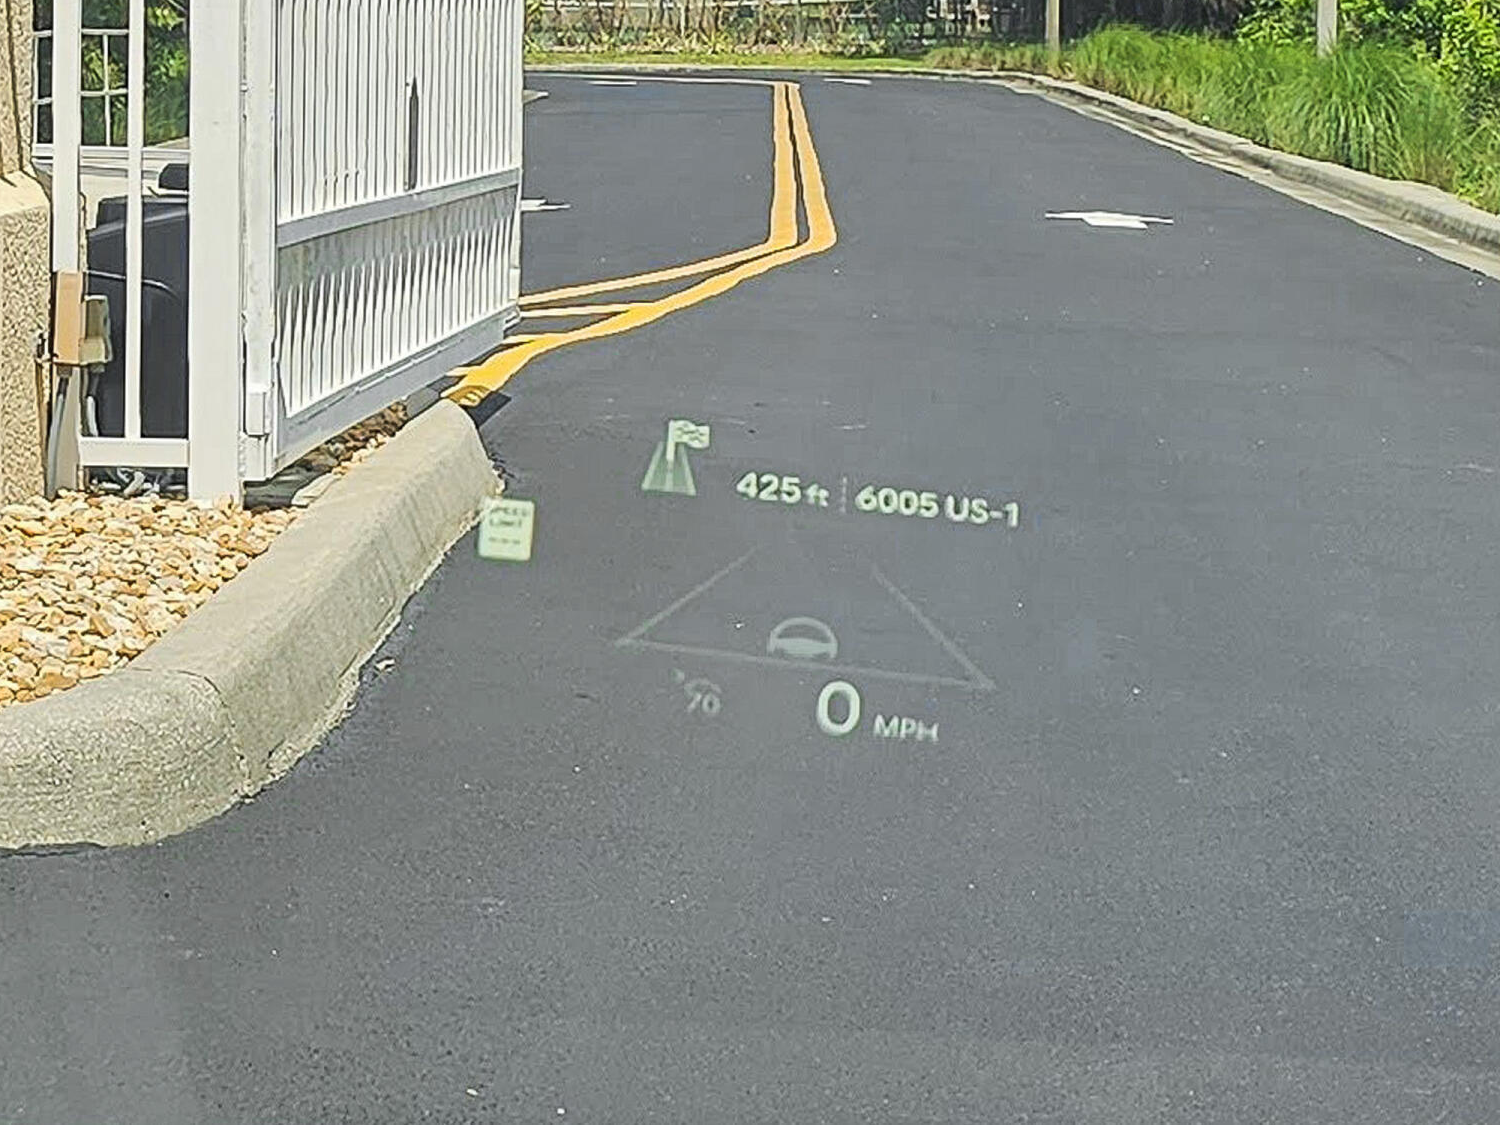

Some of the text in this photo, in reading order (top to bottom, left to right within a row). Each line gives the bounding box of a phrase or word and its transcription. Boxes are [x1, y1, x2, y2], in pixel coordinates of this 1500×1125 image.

[735, 472, 1020, 528] 425 ft 6005 US-1
[816, 679, 940, 743] 0 MPH
